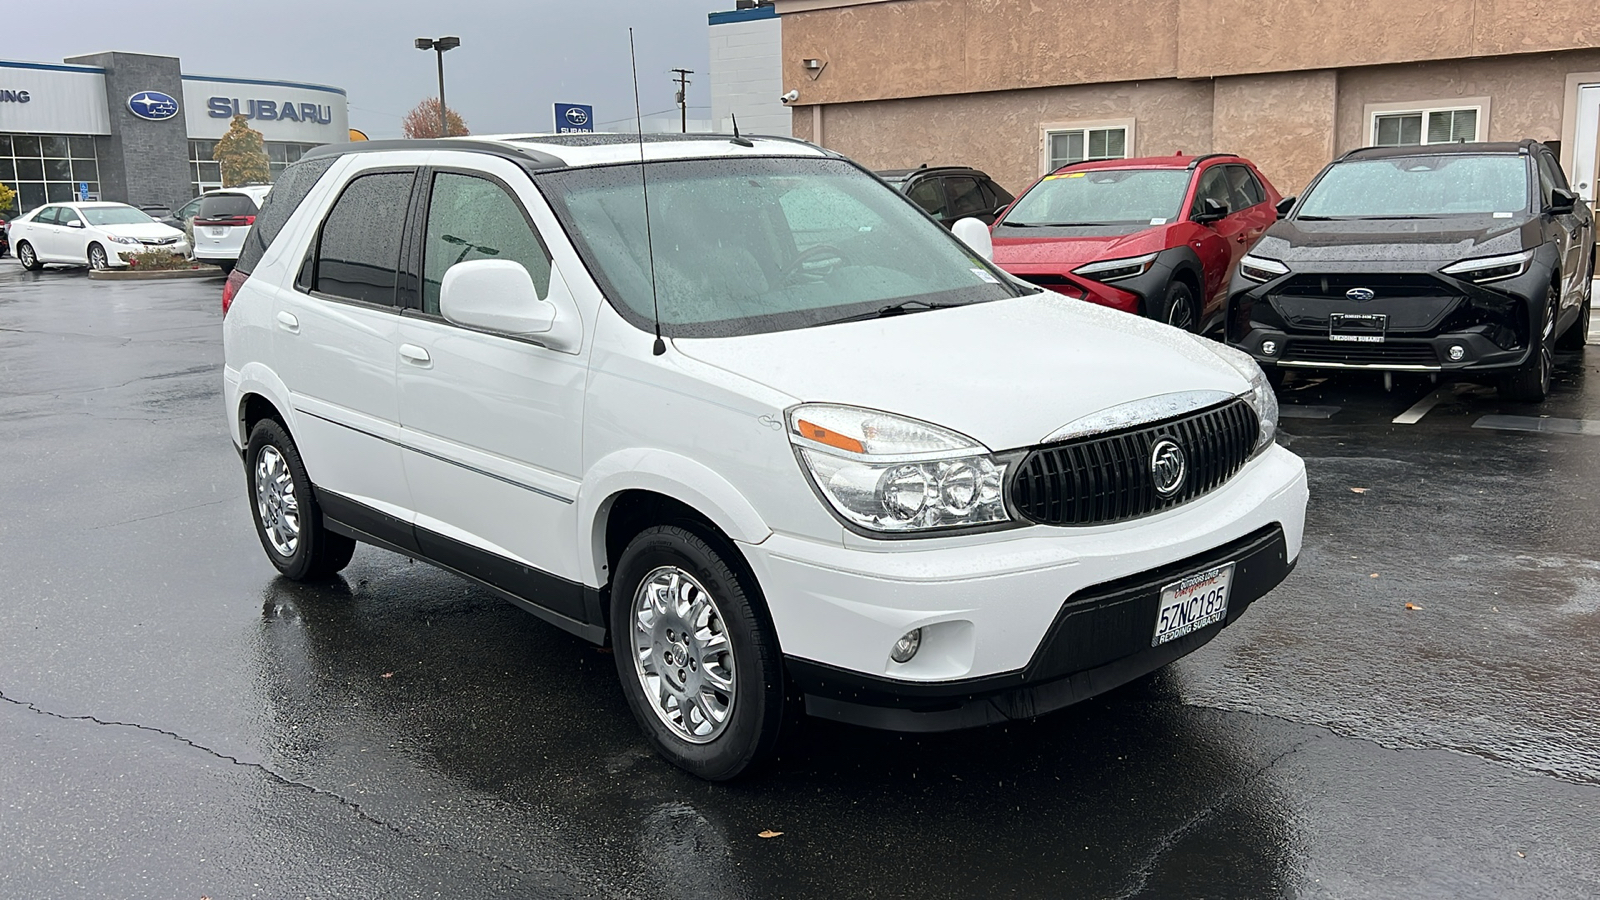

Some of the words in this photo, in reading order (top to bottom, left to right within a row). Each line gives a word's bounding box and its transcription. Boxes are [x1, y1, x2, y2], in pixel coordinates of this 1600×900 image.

[207, 96, 332, 125] SUBARU
[1159, 586, 1225, 634] 5ZNC185
[1159, 624, 1192, 645] REDDING
[1192, 611, 1221, 631] SUBARU
